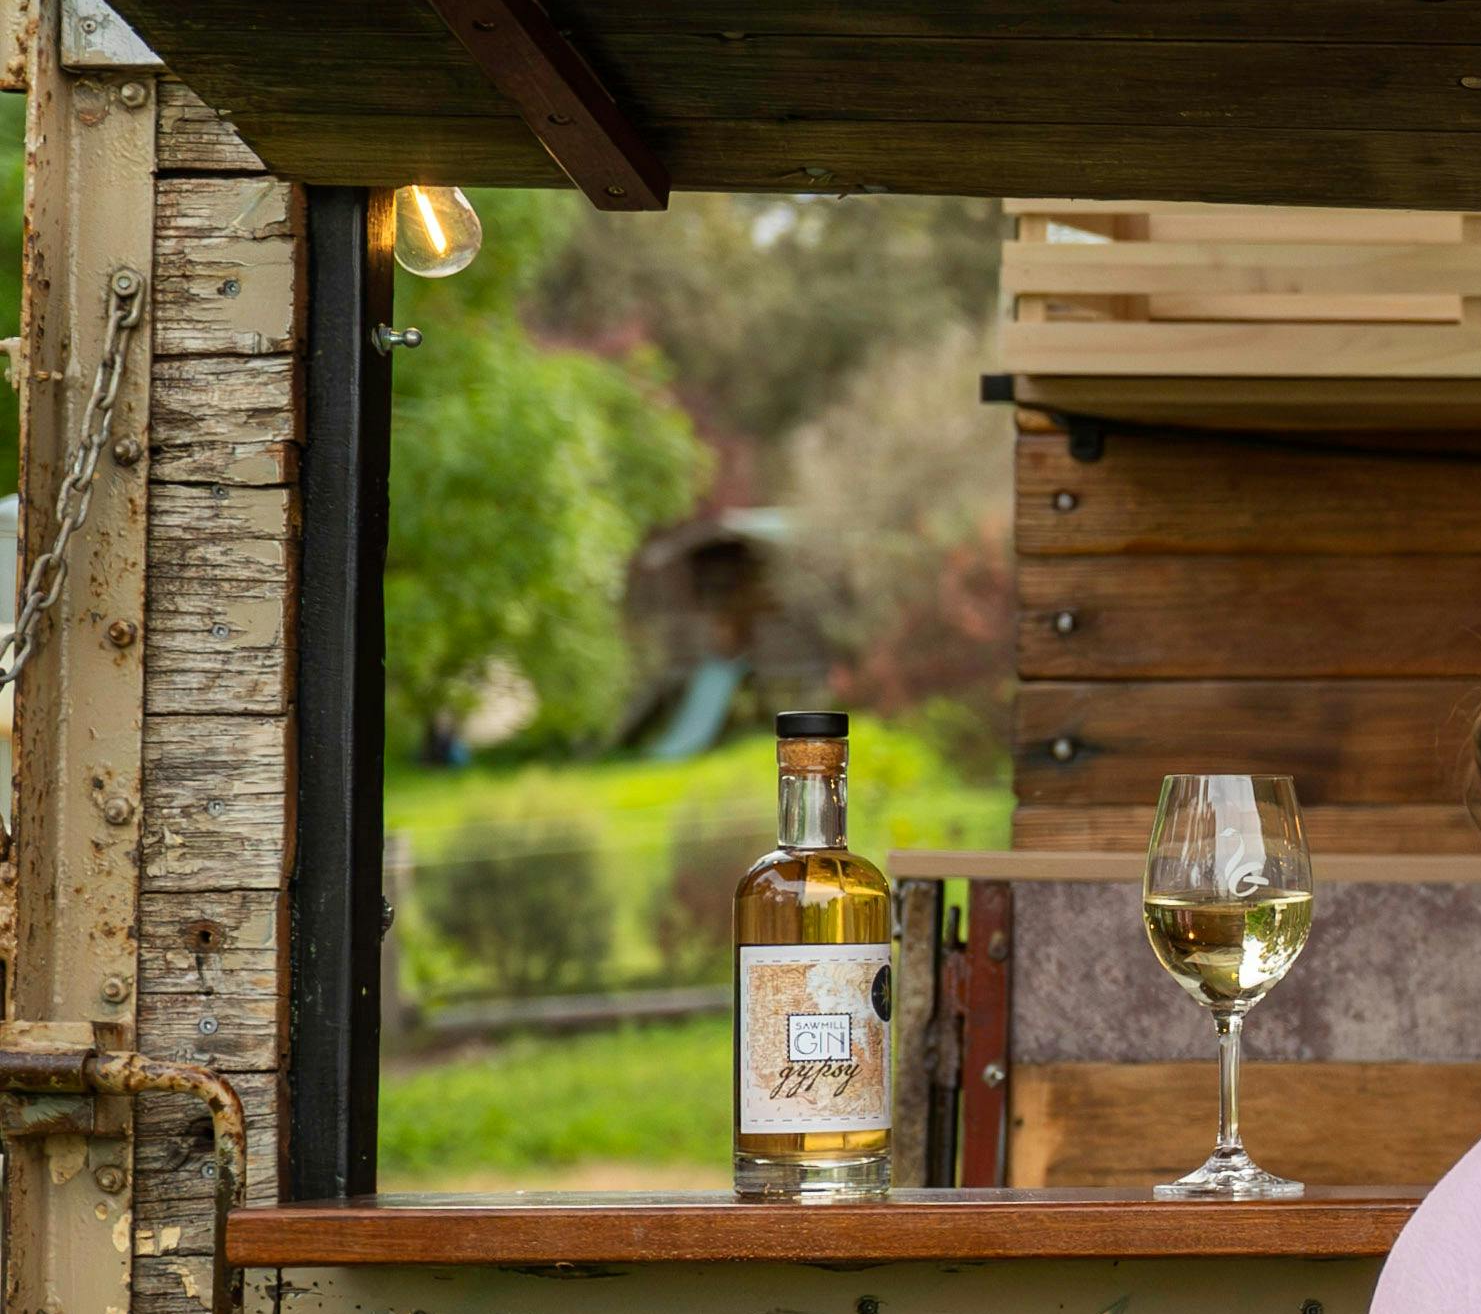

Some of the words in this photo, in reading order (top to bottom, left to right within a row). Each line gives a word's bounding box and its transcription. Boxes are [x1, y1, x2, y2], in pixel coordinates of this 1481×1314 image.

[795, 1020, 846, 1031] SAWMILL
[794, 1031, 846, 1056] GIN
[769, 1055, 863, 1100] gypsy
